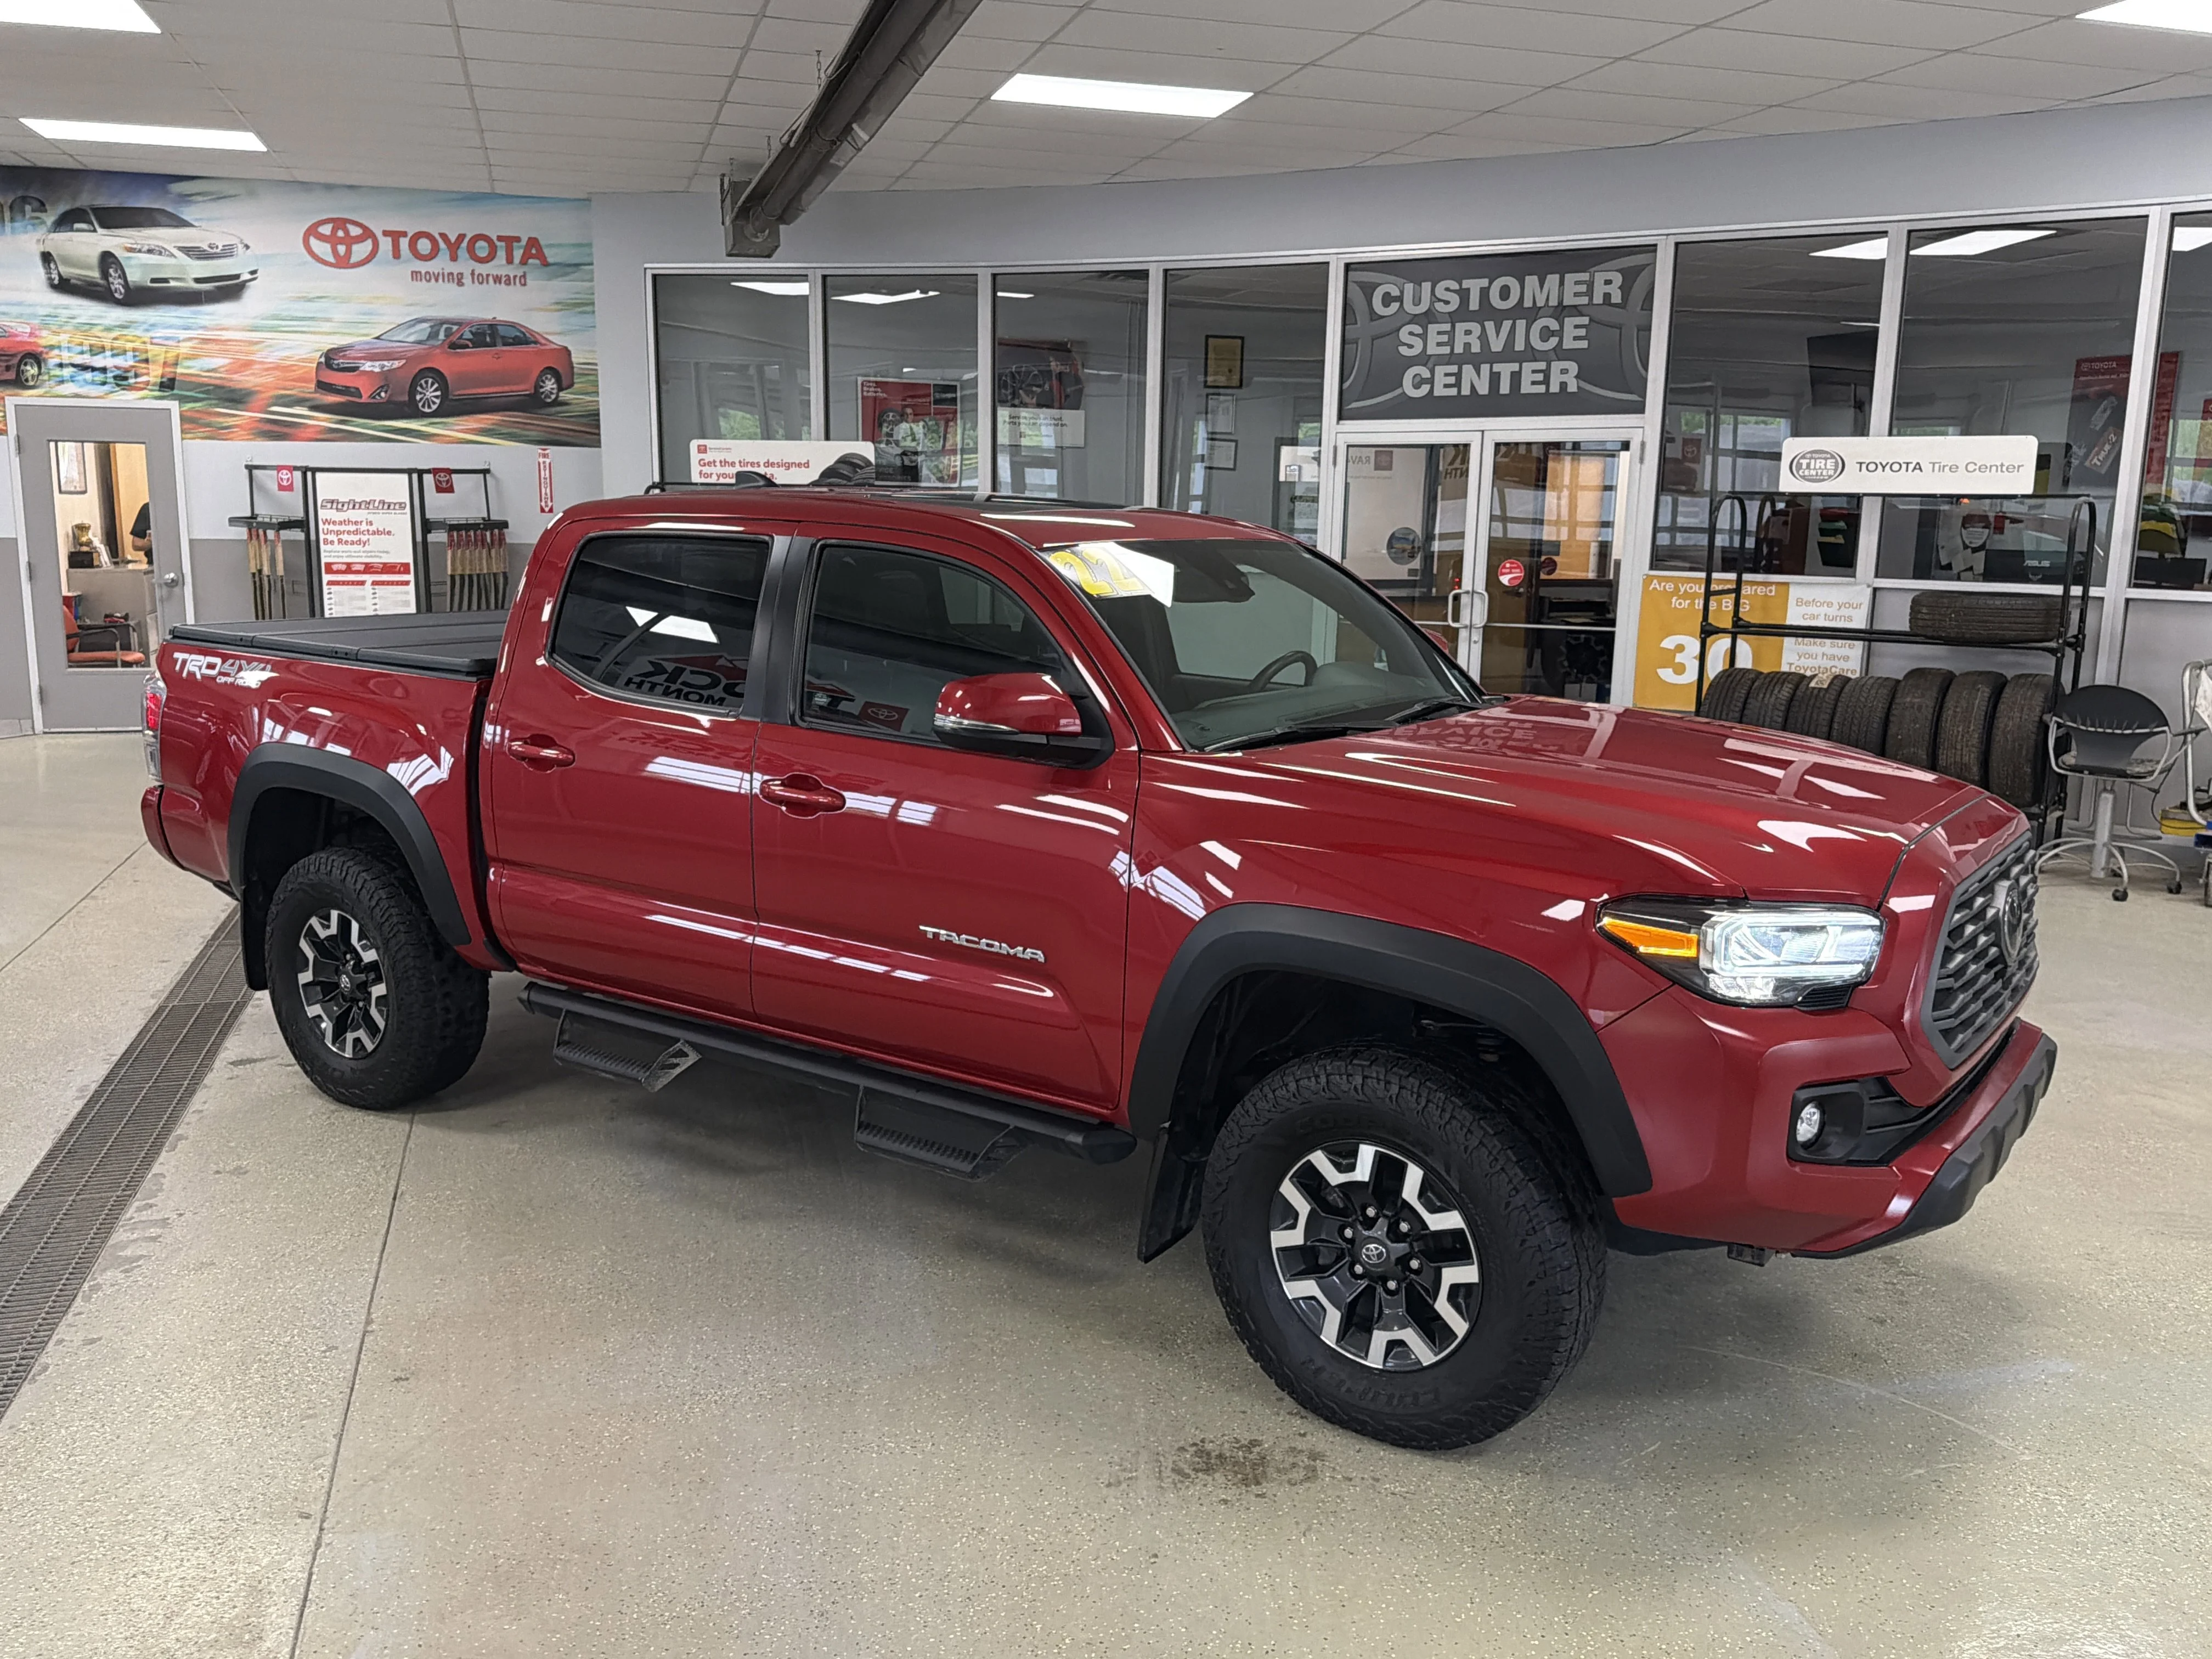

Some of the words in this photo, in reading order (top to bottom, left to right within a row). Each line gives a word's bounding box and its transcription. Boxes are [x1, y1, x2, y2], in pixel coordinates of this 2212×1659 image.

[382, 229, 549, 266] TOYOTA
[410, 268, 465, 287] moving
[470, 269, 527, 286] forward
[1372, 272, 1623, 317] CUSTOMER
[1397, 316, 1590, 357] SERVICE
[1402, 360, 1579, 398] CENTER
[698, 459, 717, 467] Get
[719, 459, 736, 467] the
[738, 459, 761, 467] tires
[763, 459, 810, 470] designed
[1799, 459, 1836, 469] TIRE
[1856, 461, 1923, 472] TOYOTA
[1928, 461, 1959, 473] Tire
[1965, 462, 2024, 473] Center
[698, 470, 714, 479] for
[715, 471, 735, 481] you
[337, 538, 370, 548] Ready!
[1049, 548, 1145, 597] 22
[1649, 579, 1674, 591] Are
[1679, 583, 1704, 594] you
[1672, 597, 1691, 609] for
[1722, 599, 1750, 612] BG
[1796, 597, 1833, 608] Before
[1837, 602, 1863, 611] your
[1824, 613, 1853, 623] turns
[1795, 638, 1826, 647] Make
[1830, 641, 1855, 649] sure
[1656, 634, 1752, 685] 30
[1797, 652, 1818, 661] you
[1821, 652, 1850, 662] have
[173, 652, 222, 681] TRD
[217, 676, 234, 686] OFF
[235, 678, 262, 689] ROD
[919, 925, 1045, 963] TACOMA
